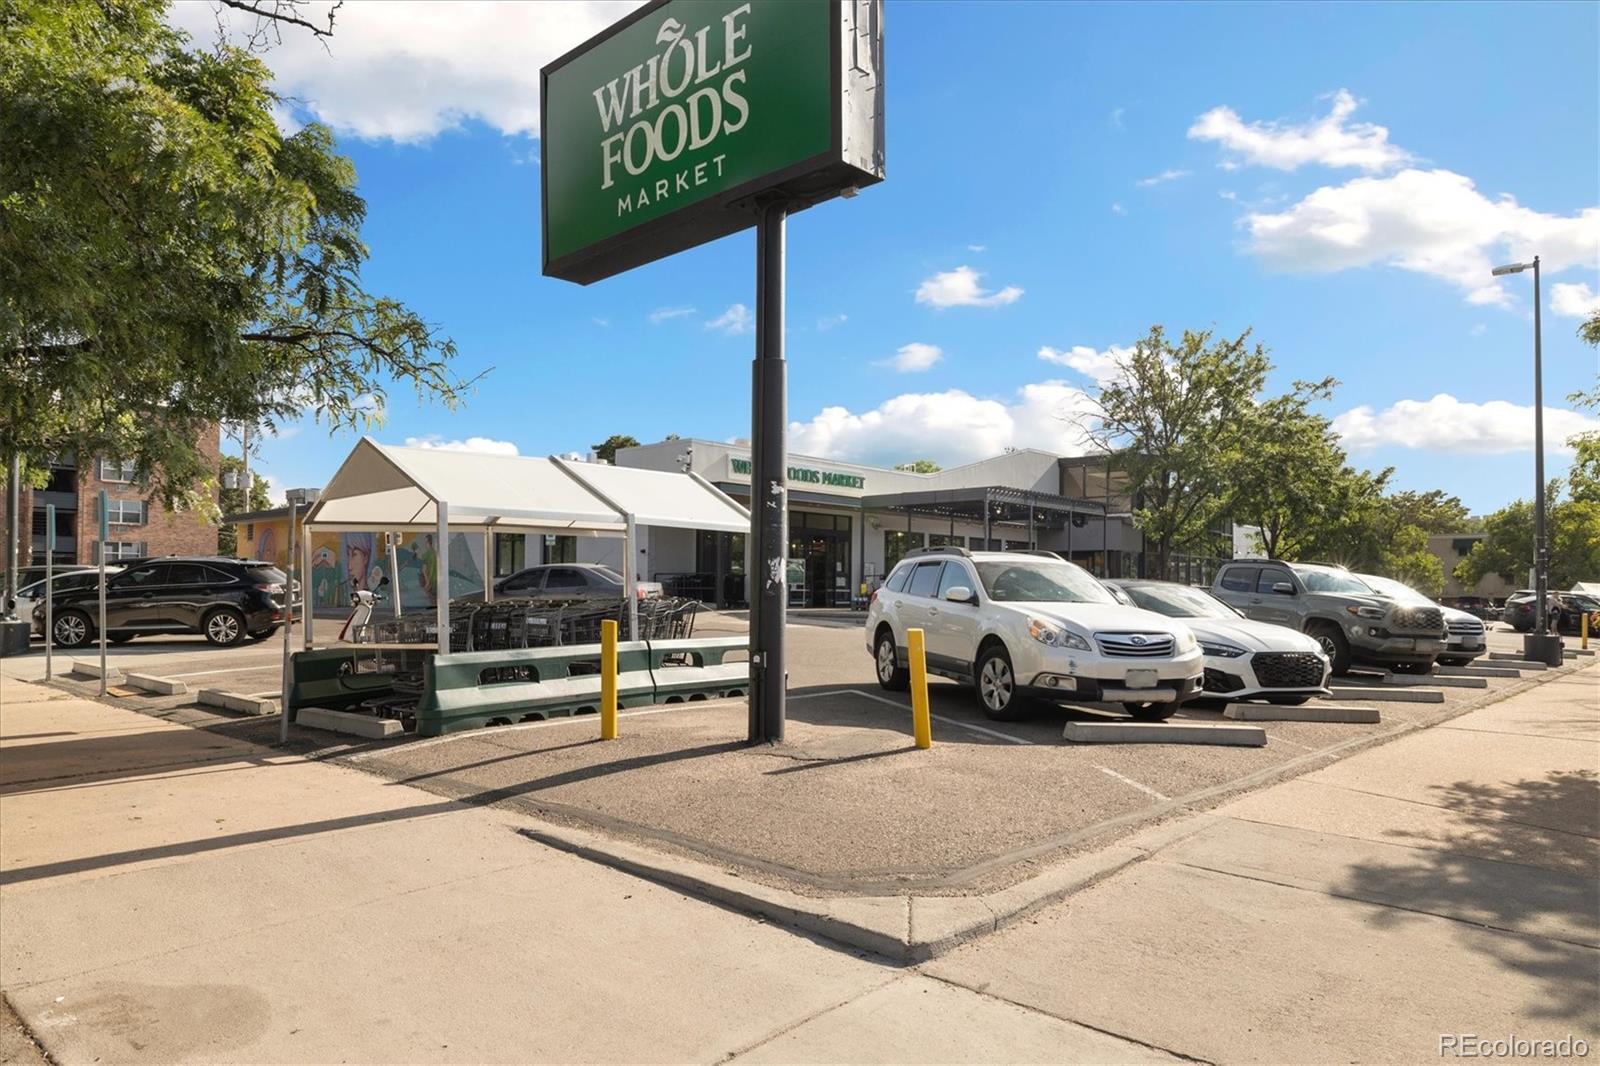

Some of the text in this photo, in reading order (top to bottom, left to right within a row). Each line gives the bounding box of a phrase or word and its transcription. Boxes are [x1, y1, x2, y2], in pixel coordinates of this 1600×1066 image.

[592, 3, 752, 133] WHOLE
[600, 69, 750, 190] FOODS
[617, 154, 727, 217] MARKET
[787, 466, 866, 489] OODS MARKET
